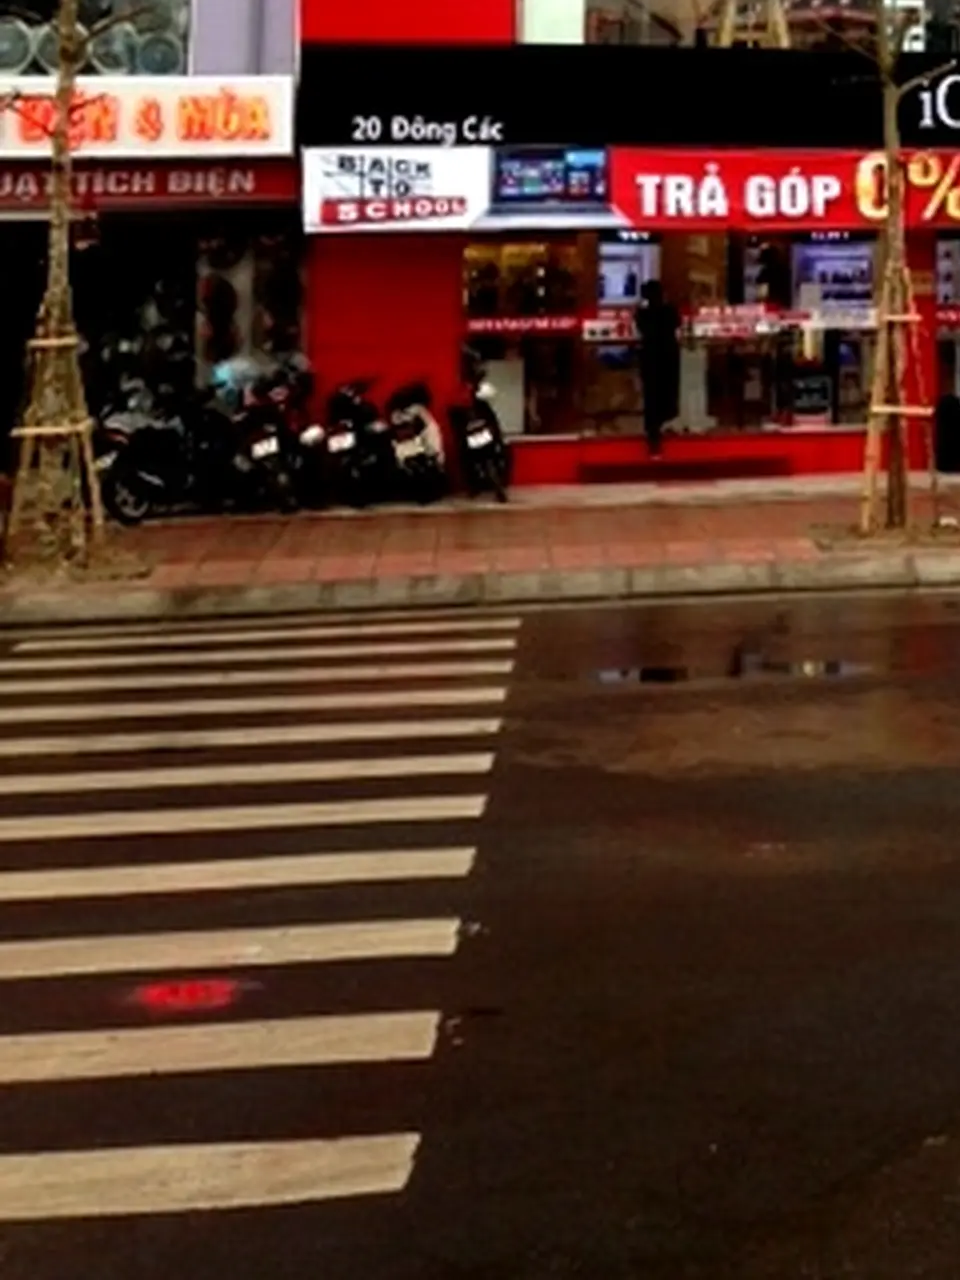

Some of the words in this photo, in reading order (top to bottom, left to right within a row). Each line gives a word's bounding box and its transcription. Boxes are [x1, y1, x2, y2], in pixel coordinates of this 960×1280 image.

[351, 116, 382, 141] 20
[336, 154, 431, 179] BACK
[76, 168, 156, 195] TÍCH
[167, 168, 256, 198] ĐIỆN
[369, 178, 411, 197] TO
[635, 161, 730, 217] TRẢ
[743, 166, 842, 218] GÓP
[336, 196, 468, 221] SCHOOL
